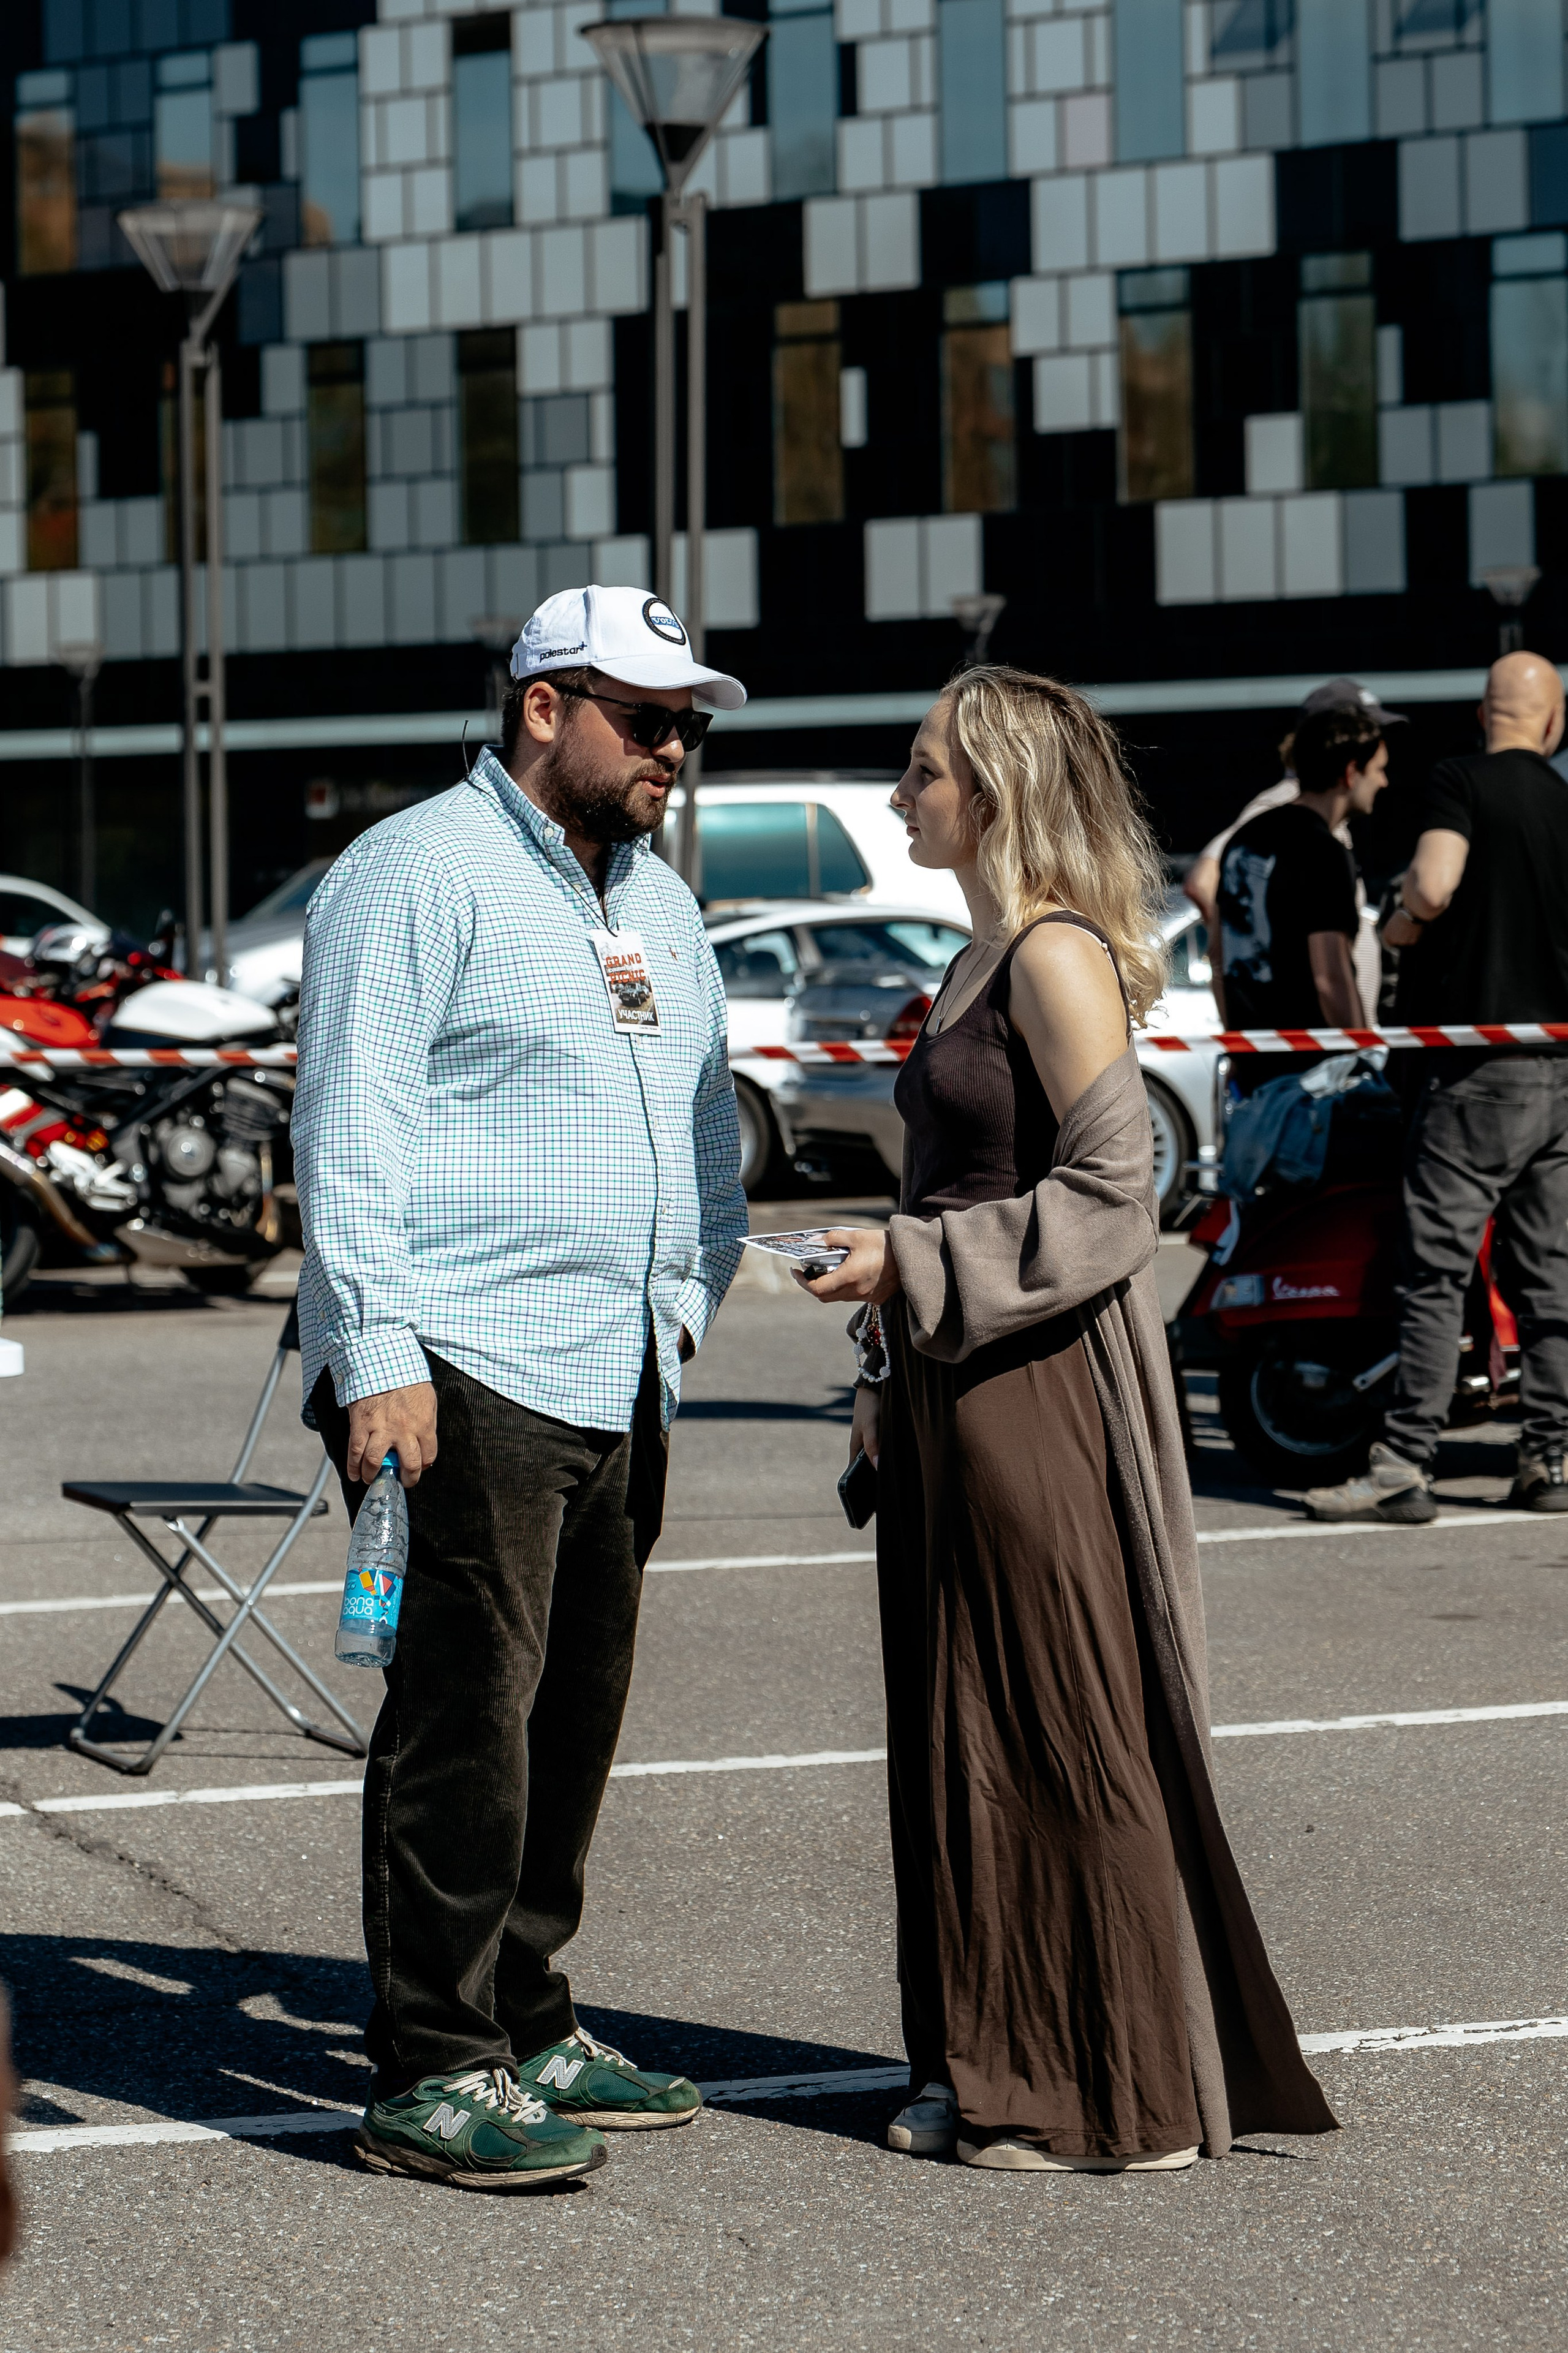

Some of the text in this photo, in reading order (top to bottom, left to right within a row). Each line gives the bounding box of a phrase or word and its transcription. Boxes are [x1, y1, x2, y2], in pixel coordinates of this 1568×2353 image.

[540, 647, 582, 663] polestar
[606, 953, 641, 967] GRAND
[609, 969, 646, 984] PICNIC
[618, 1010, 654, 1021] УЧАСТНИК
[343, 1606, 372, 1616] aqua
[535, 2055, 584, 2090] N
[422, 2102, 472, 2140] N
